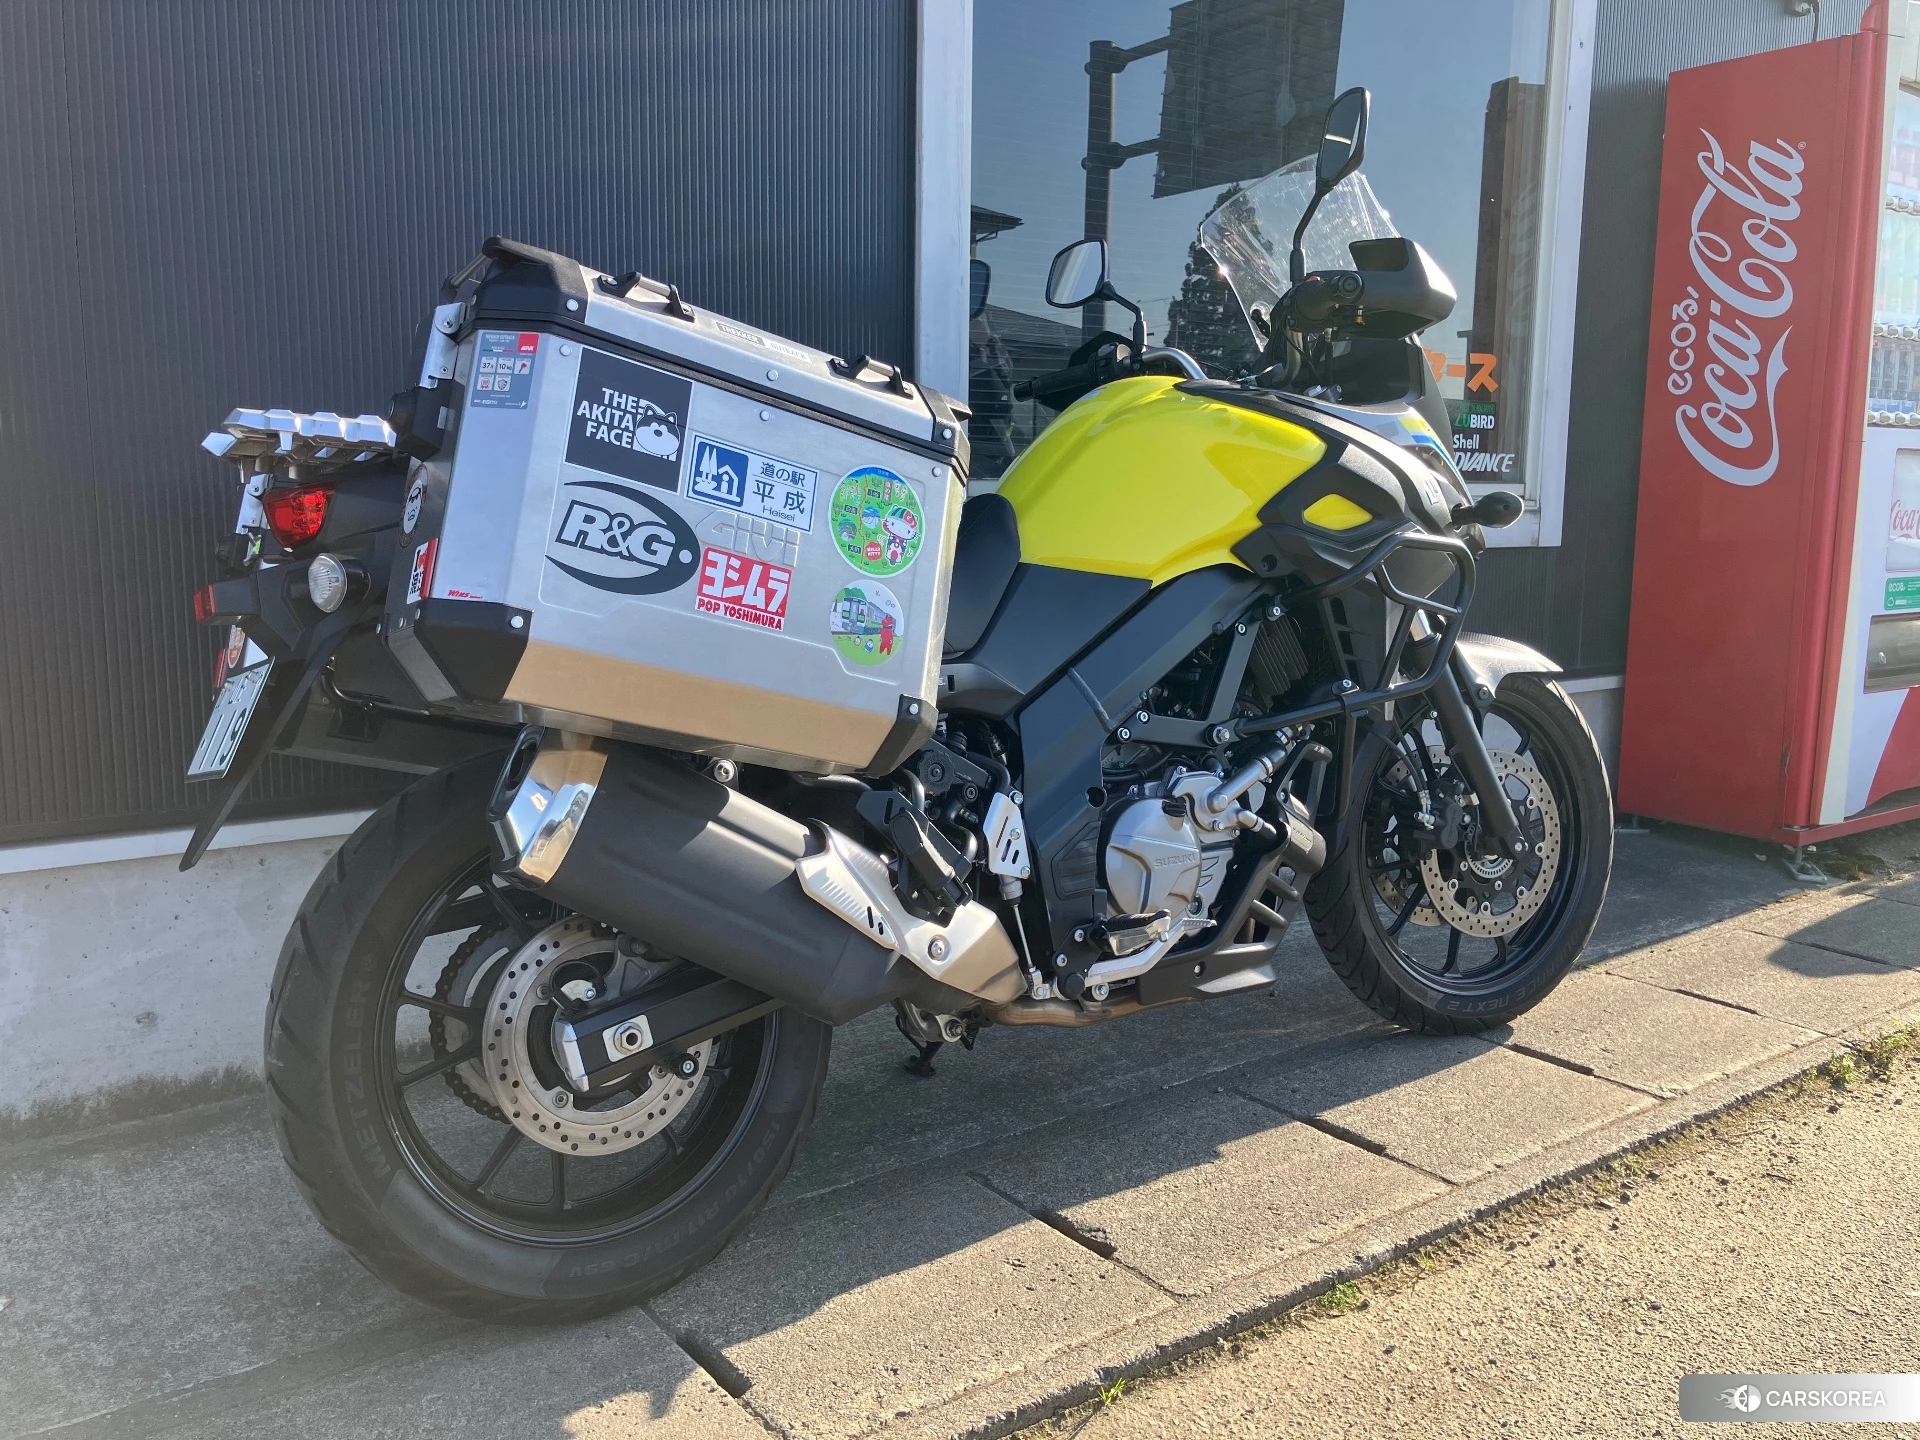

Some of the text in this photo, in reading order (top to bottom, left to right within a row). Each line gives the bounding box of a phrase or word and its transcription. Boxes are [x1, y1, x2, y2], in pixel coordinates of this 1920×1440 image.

[1676, 127, 1806, 486] Coca-Cola
[720, 325, 759, 343] TREKKER
[602, 387, 638, 413] THE
[576, 400, 634, 431] AKITA
[585, 420, 633, 449] FACE
[1452, 434, 1480, 450] Shell
[760, 461, 806, 488] 道の駅
[1453, 451, 1515, 473] DVANCE
[752, 479, 807, 515] 平成
[762, 504, 796, 522] Heisei
[556, 500, 676, 566] R&G
[702, 550, 790, 613] ヨシムラ
[697, 597, 782, 631] POP YOSHIMURA
[1154, 852, 1196, 869] SUZUKI
[1461, 993, 1510, 1013] NEXT
[342, 979, 392, 1181] METZELER
